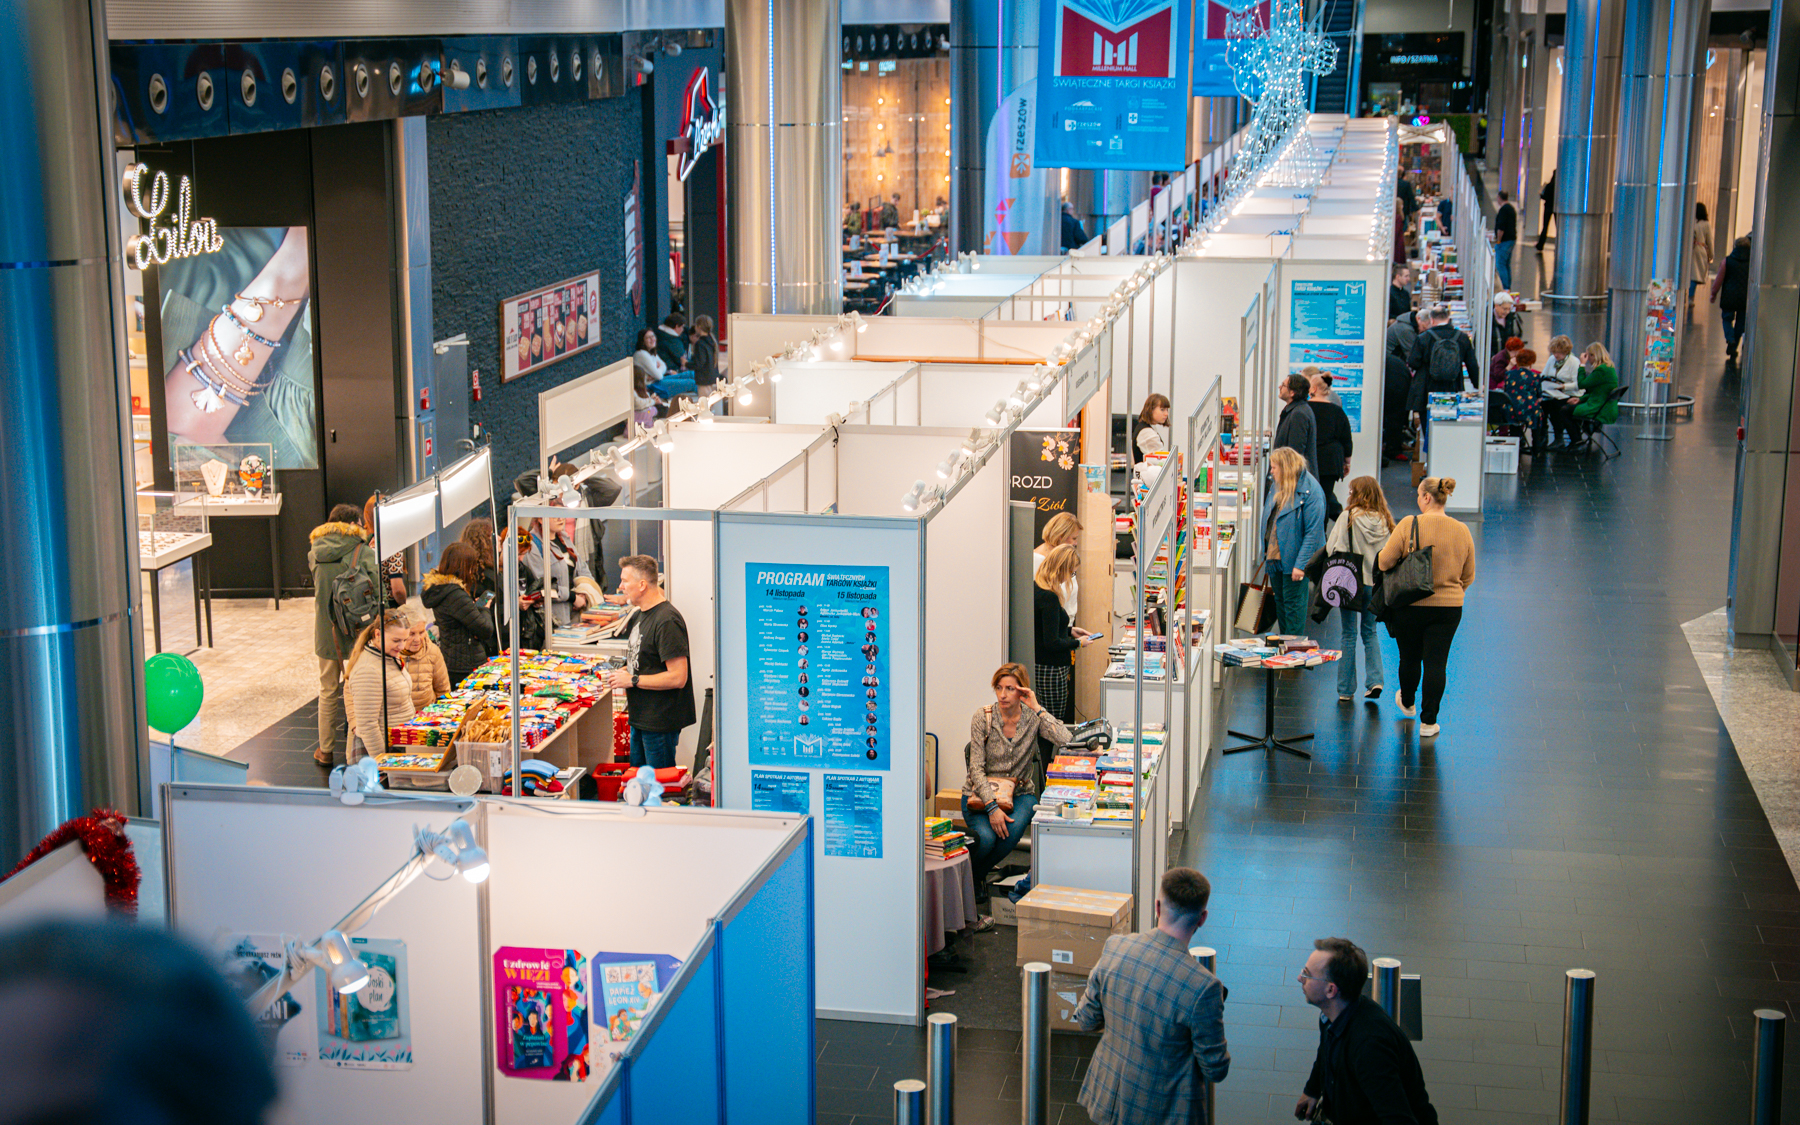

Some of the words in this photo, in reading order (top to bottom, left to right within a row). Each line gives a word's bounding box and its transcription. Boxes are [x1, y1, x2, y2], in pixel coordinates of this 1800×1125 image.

[1053, 77, 1112, 90] ŚWIĄTECZNE
[1115, 79, 1140, 89] TARGI
[1143, 80, 1176, 91] KSIĄŻKI
[1016, 98, 1027, 151] rzeszów
[1010, 475, 1053, 489] ROZD
[757, 571, 826, 587] PROGRAM
[826, 573, 866, 582] ŚWIĄTECZNYCH
[826, 579, 852, 588] TARGÓW
[853, 579, 877, 588] KSIĄŻKI
[775, 589, 805, 599] listopada
[837, 591, 845, 599] 15
[846, 591, 877, 601] listopada
[504, 969, 550, 983] WIĘZI
[609, 984, 635, 997] PAPIEŻ
[369, 991, 382, 1004] plan
